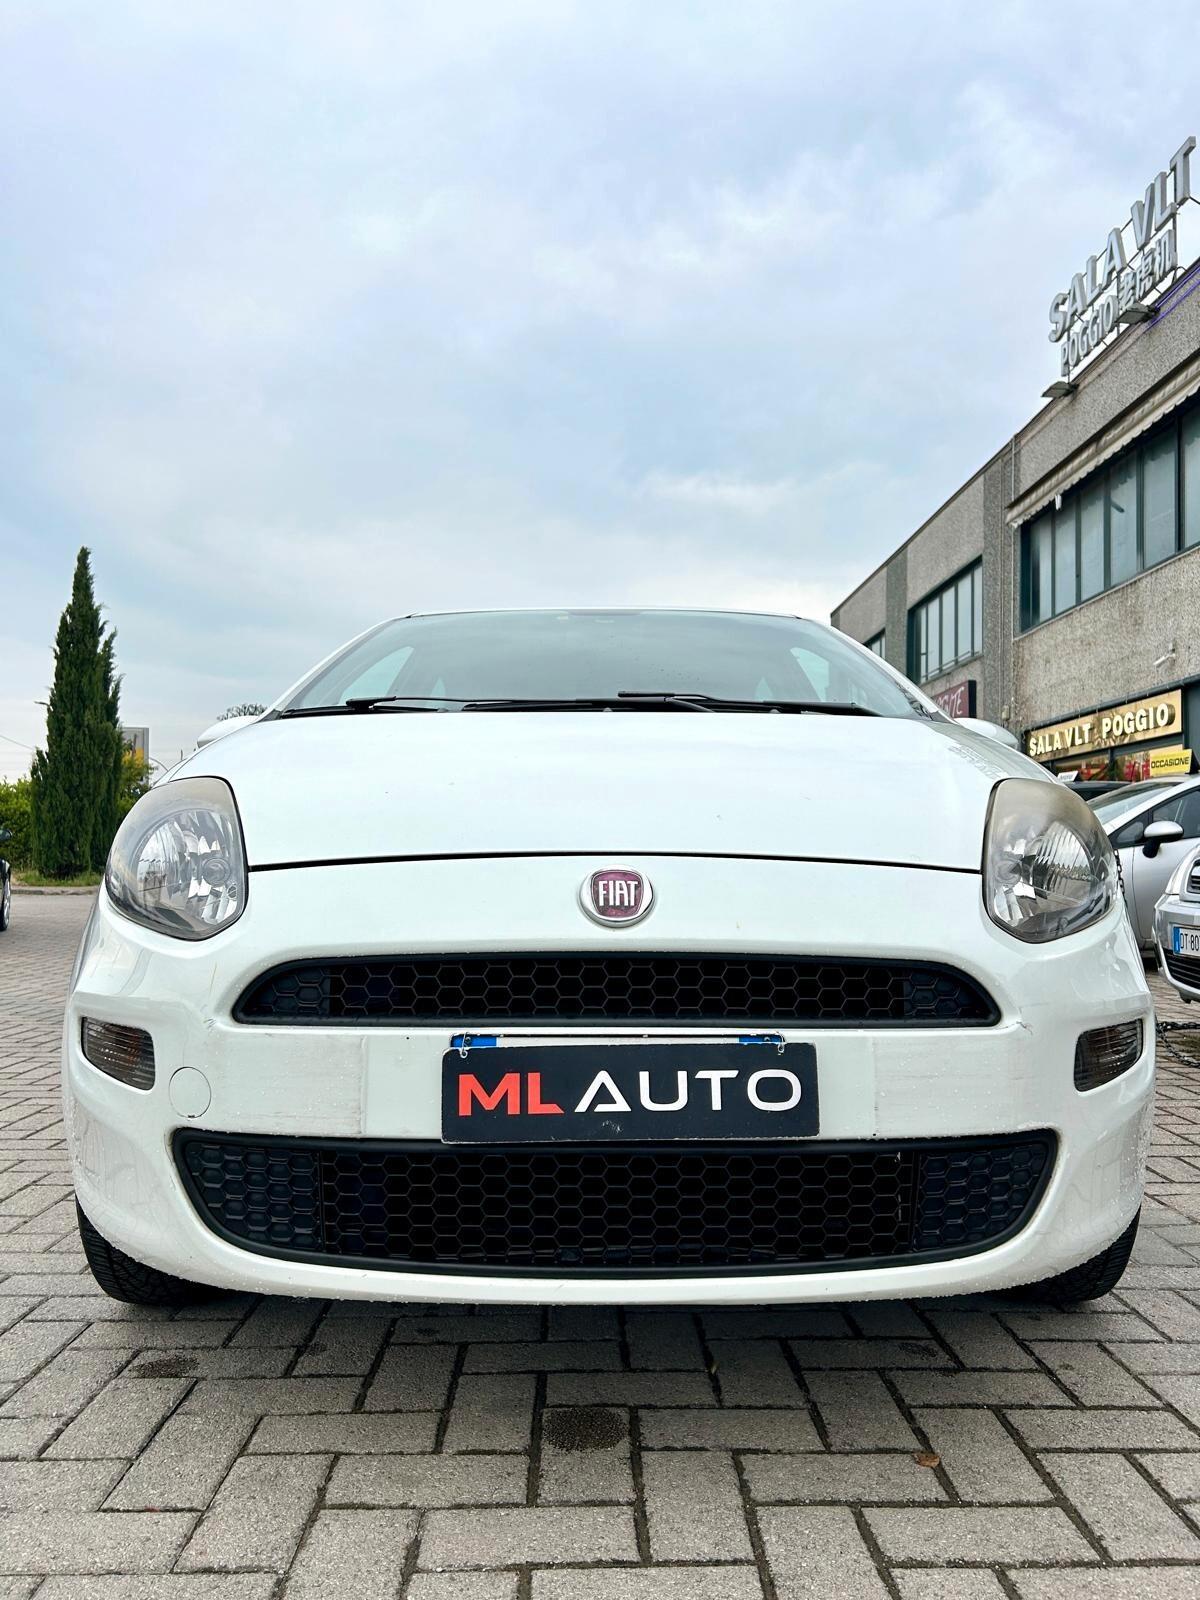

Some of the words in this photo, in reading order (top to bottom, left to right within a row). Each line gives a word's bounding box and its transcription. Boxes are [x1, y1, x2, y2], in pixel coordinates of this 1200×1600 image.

[1048, 227, 1127, 343] SALA
[1130, 136, 1197, 251] VLT
[1061, 294, 1119, 377] POGGIO
[1029, 731, 1061, 757] SALA
[1064, 722, 1092, 748] VLT
[1102, 703, 1172, 739] POGGIO
[1151, 756, 1190, 769] OCCASIONE
[598, 880, 638, 906] FIAT
[458, 1072, 565, 1116] ML
[574, 1069, 802, 1114] AUTO
